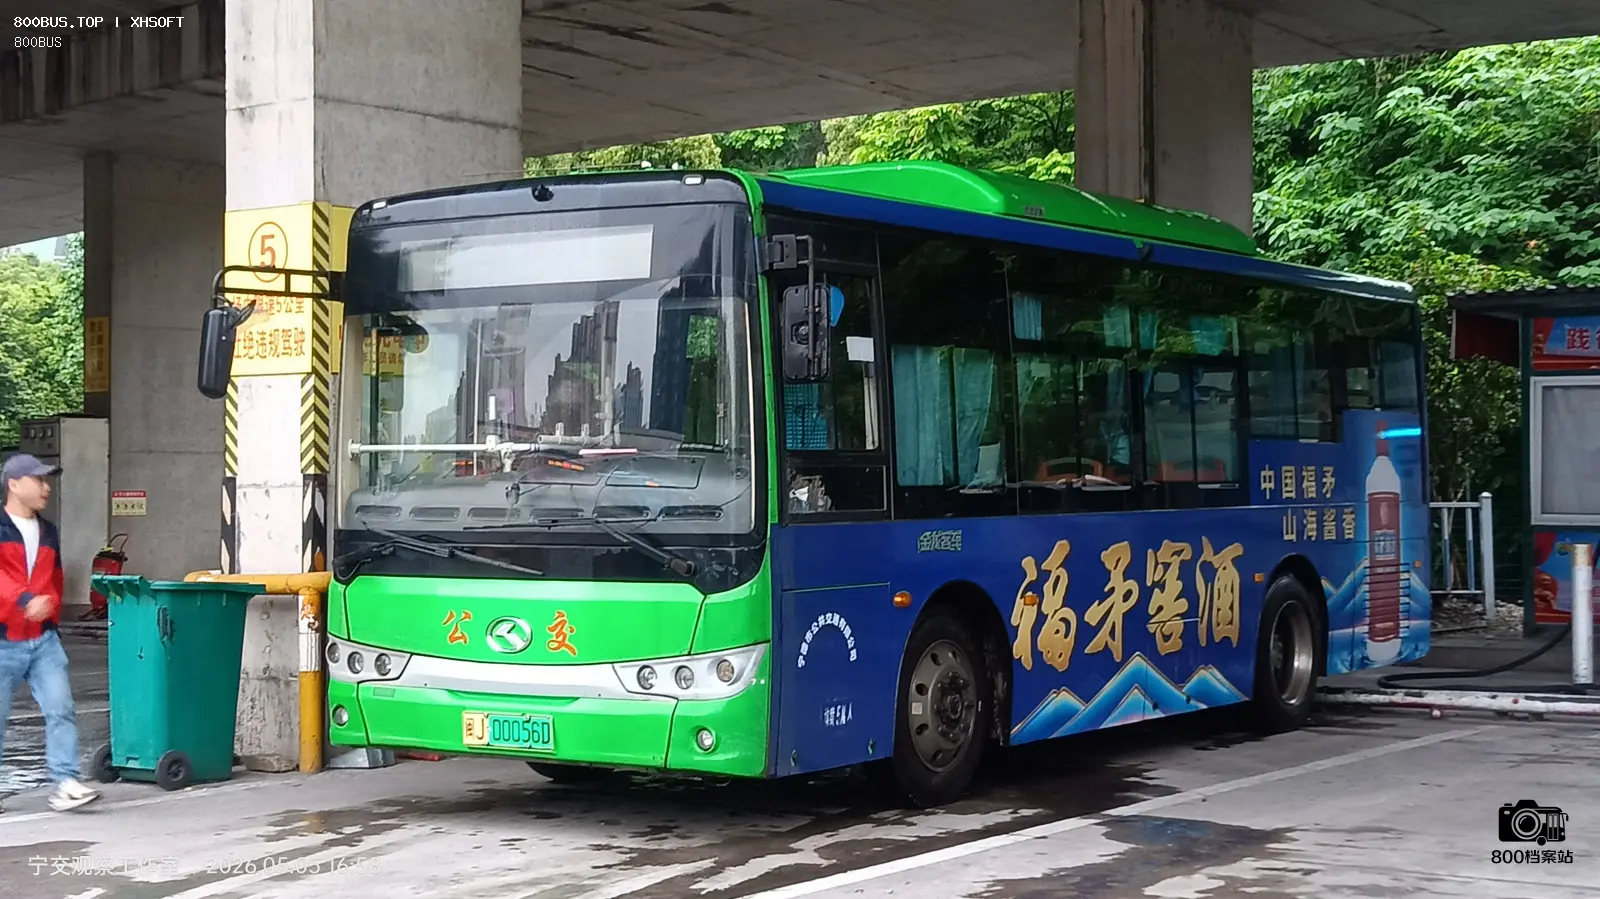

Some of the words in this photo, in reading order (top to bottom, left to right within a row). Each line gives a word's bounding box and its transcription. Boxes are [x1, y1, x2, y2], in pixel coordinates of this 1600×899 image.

[260, 234, 276, 269] 5
[1260, 464, 1336, 499] 中国福矛
[1282, 507, 1356, 542] 山海酱香
